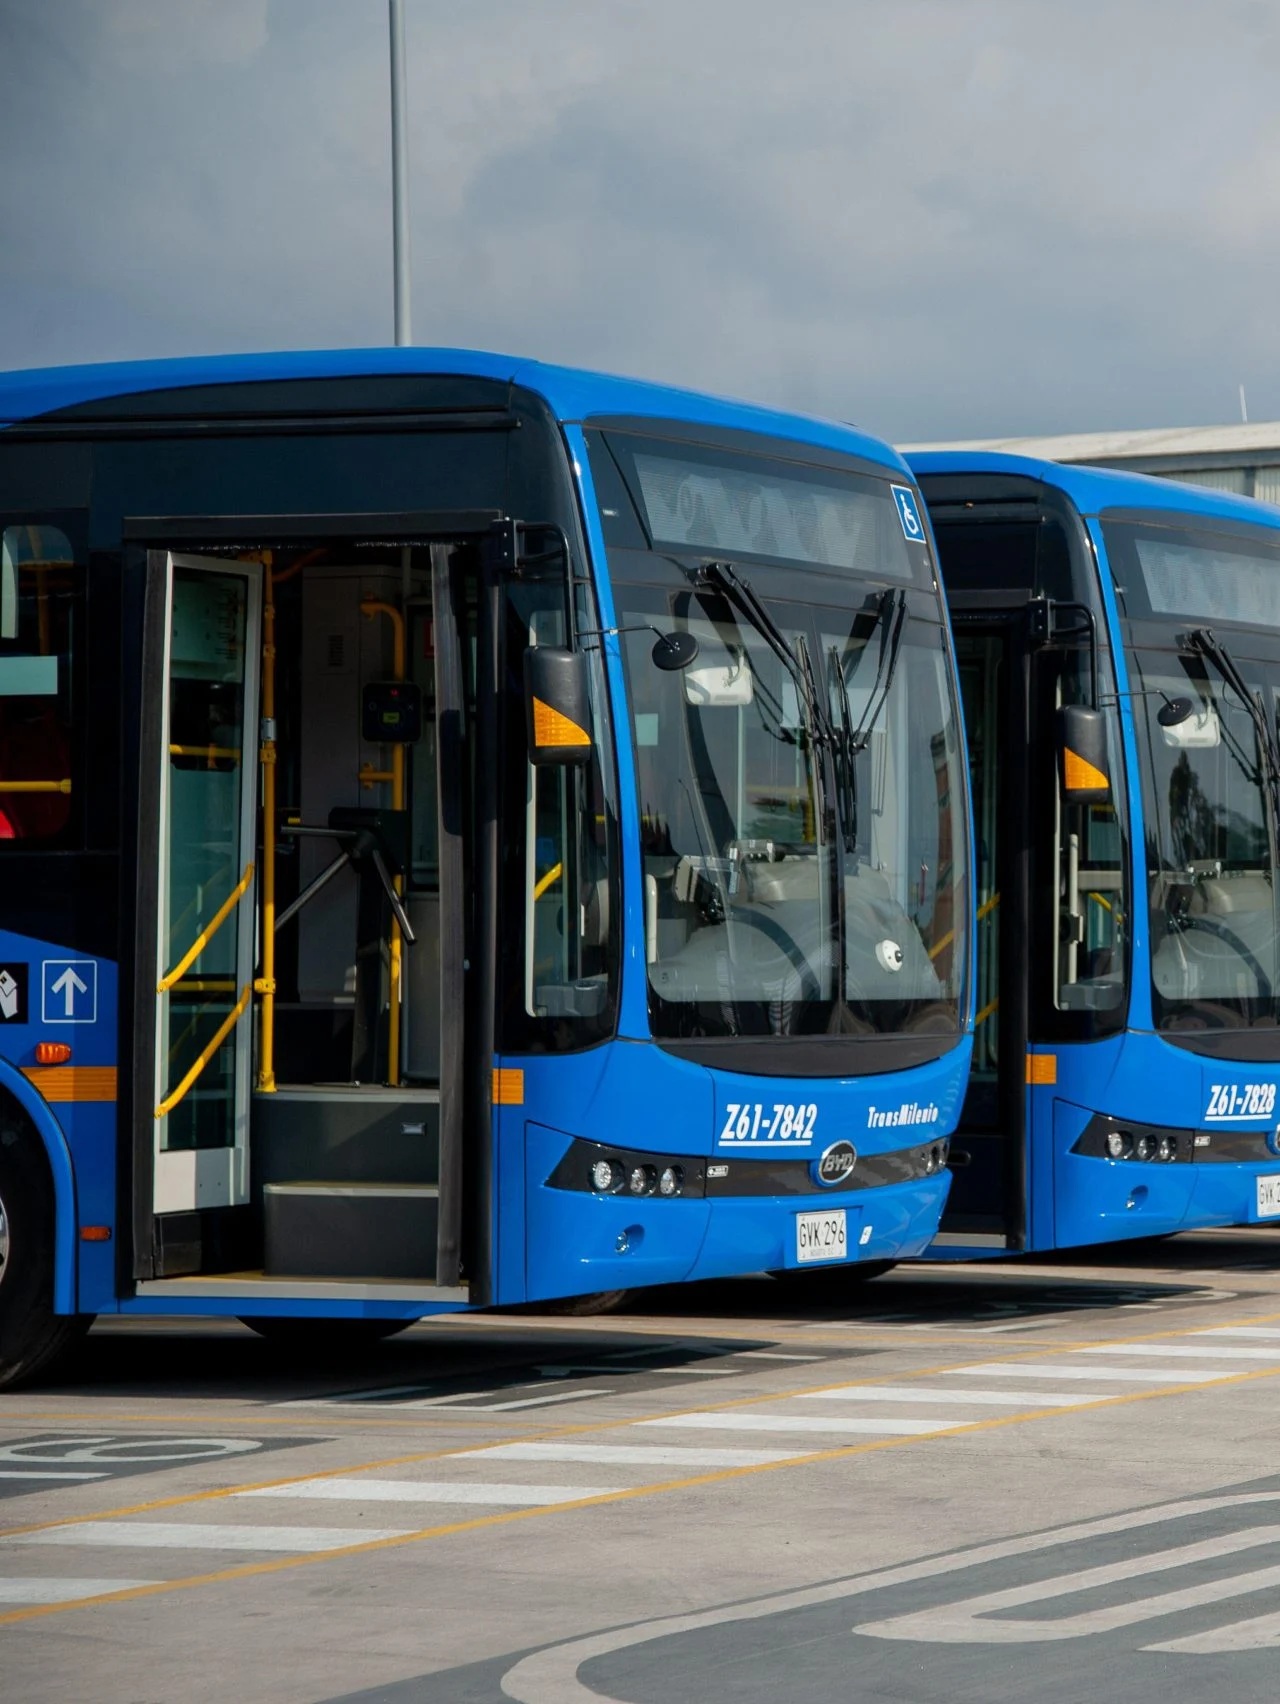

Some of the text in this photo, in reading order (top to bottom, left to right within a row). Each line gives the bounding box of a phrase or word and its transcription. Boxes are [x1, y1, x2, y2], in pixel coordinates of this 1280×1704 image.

[1206, 1084, 1276, 1115] Z61-7828
[721, 1104, 818, 1140] Z61-7842
[867, 1103, 939, 1129] TransMilenio
[823, 1153, 853, 1173] BYD
[1260, 1184, 1274, 1204] GVK
[800, 1220, 845, 1247] GVK 296
